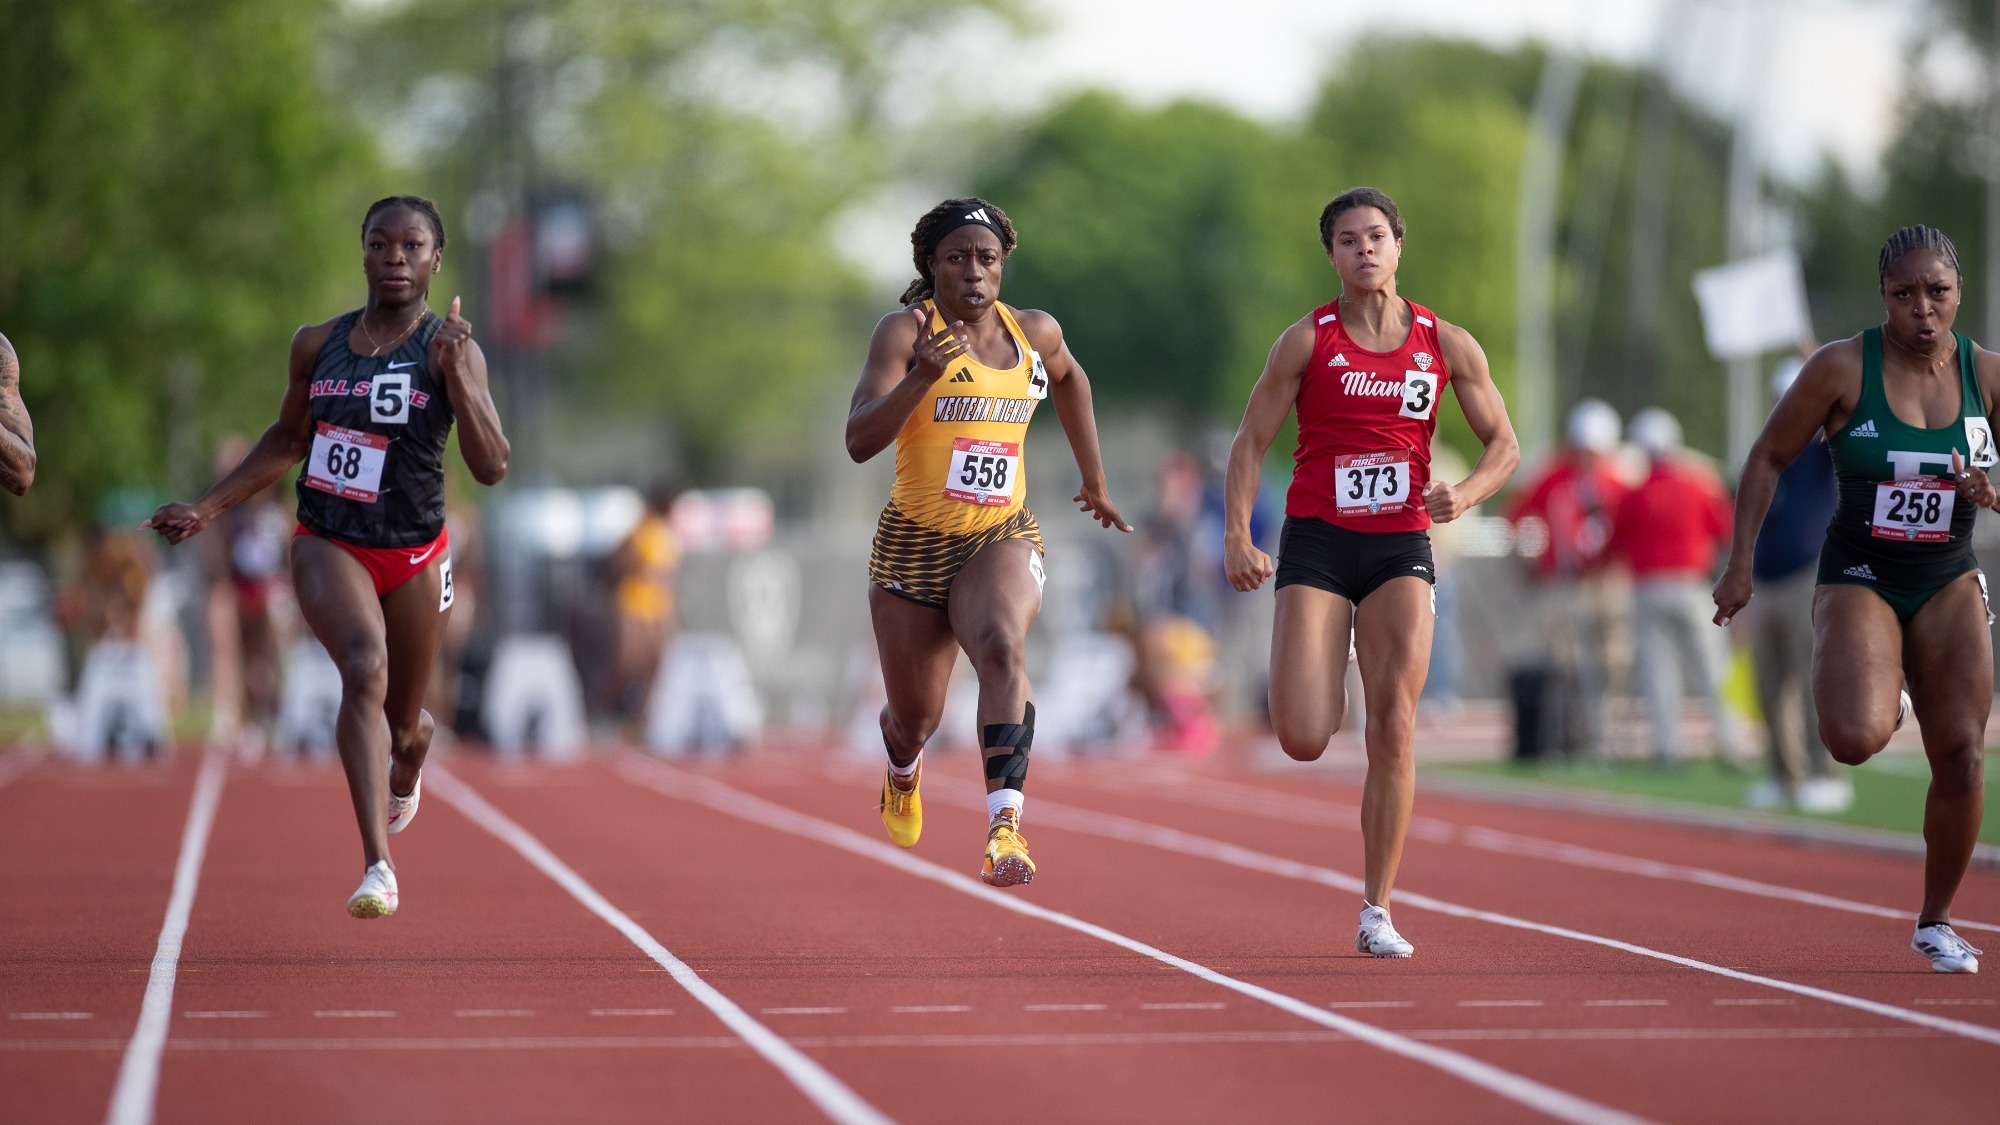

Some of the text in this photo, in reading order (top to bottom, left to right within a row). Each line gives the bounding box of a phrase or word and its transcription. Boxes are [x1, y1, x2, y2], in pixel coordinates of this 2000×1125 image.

[309, 379, 350, 400] ALL
[374, 382, 403, 417] 5
[1340, 371, 1406, 398] Miam
[1406, 379, 1431, 413] 3
[933, 396, 994, 423] WESTERN
[1849, 429, 1880, 438] adidas
[1968, 427, 1993, 462] 2
[327, 443, 362, 480] 68
[960, 454, 1008, 490] 558
[1347, 465, 1398, 500] 373
[1886, 489, 1941, 525] 258
[1843, 568, 1877, 581] adidas
